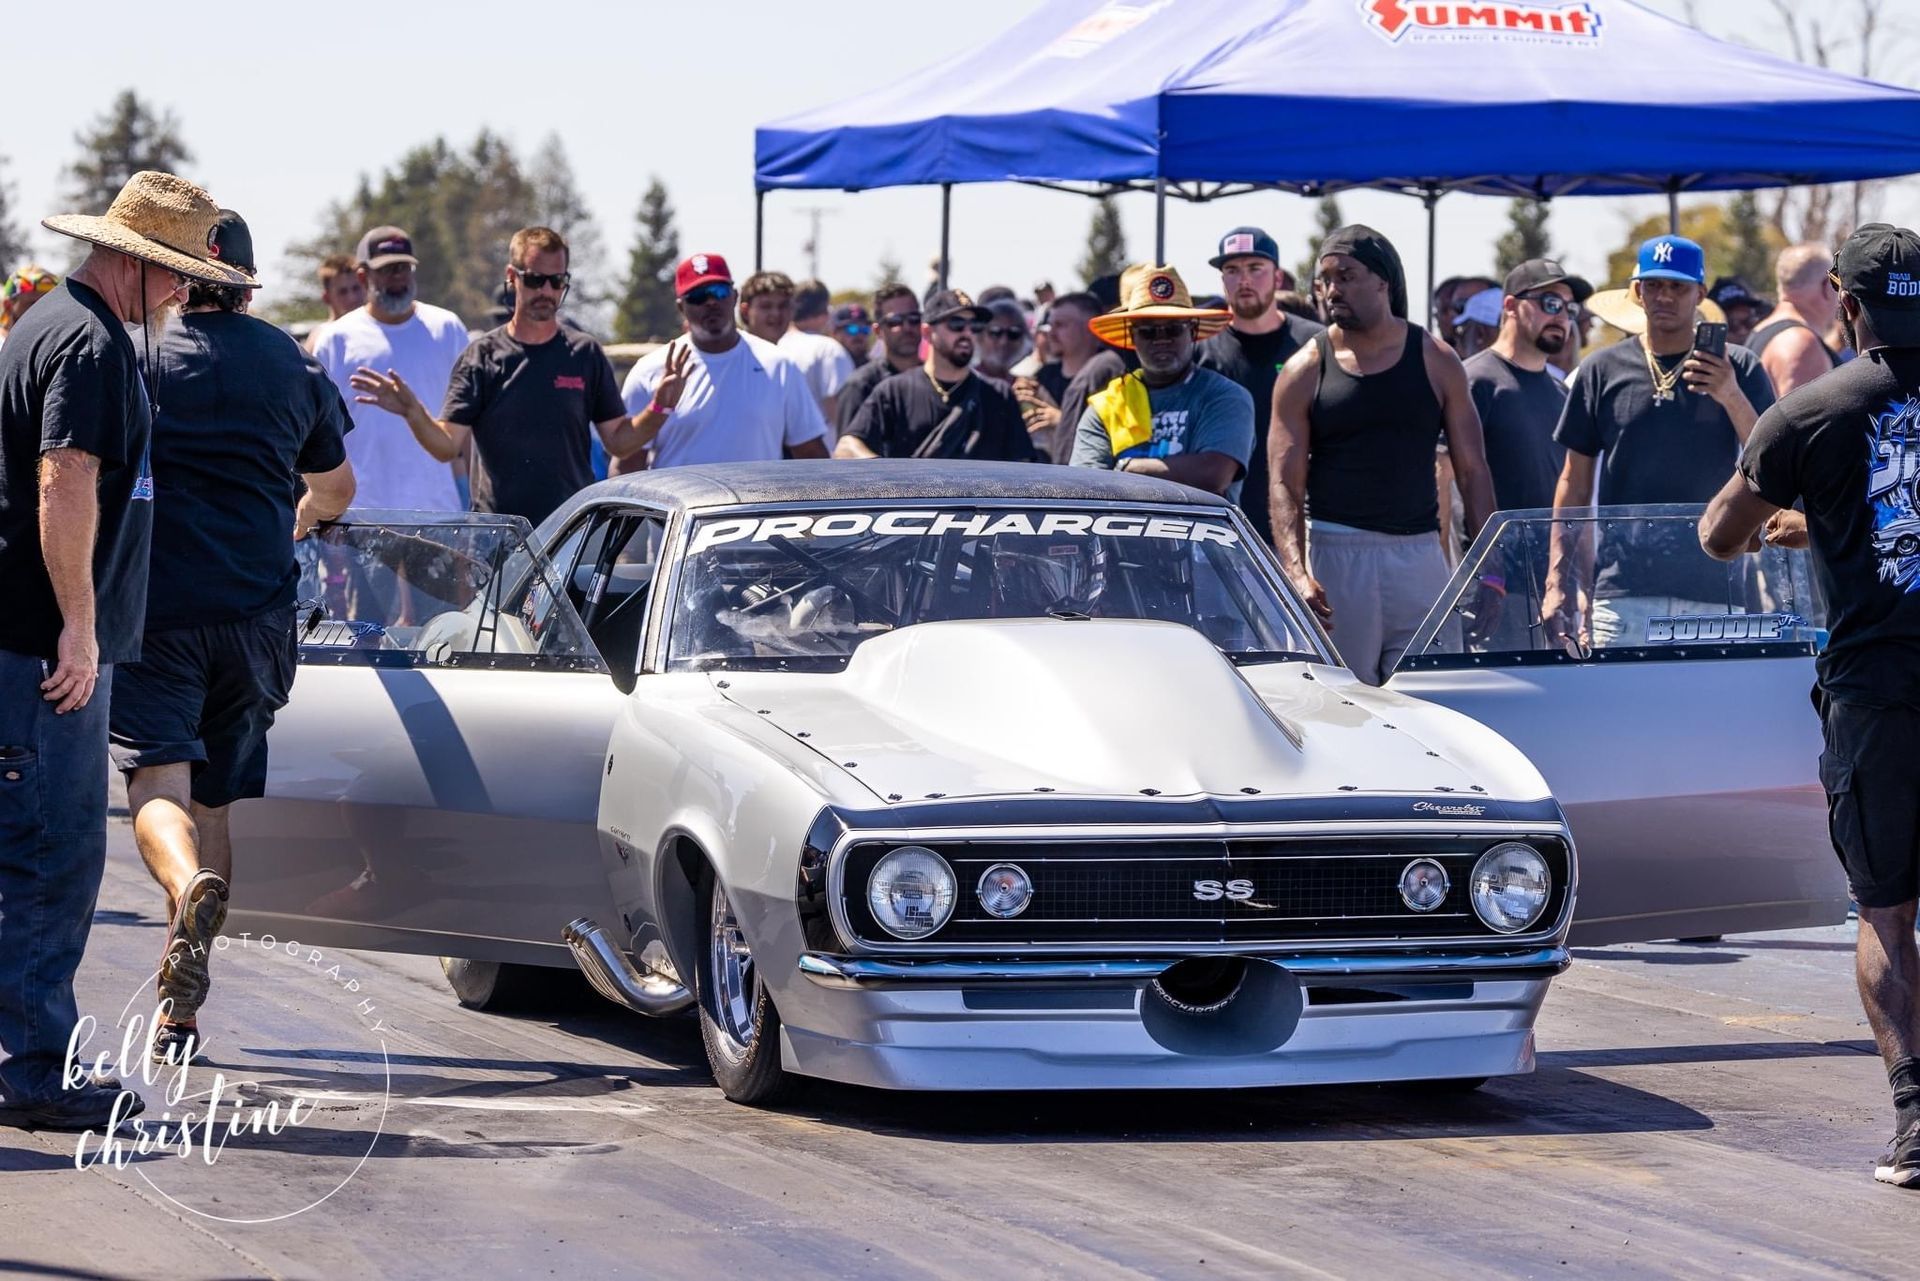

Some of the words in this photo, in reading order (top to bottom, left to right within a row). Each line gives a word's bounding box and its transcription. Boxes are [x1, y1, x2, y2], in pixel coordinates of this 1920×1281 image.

[1887, 280, 1920, 296] BOD
[687, 511, 1239, 555] PROCHARGER
[1648, 614, 1782, 642] BODDIE
[1193, 879, 1255, 901] SS
